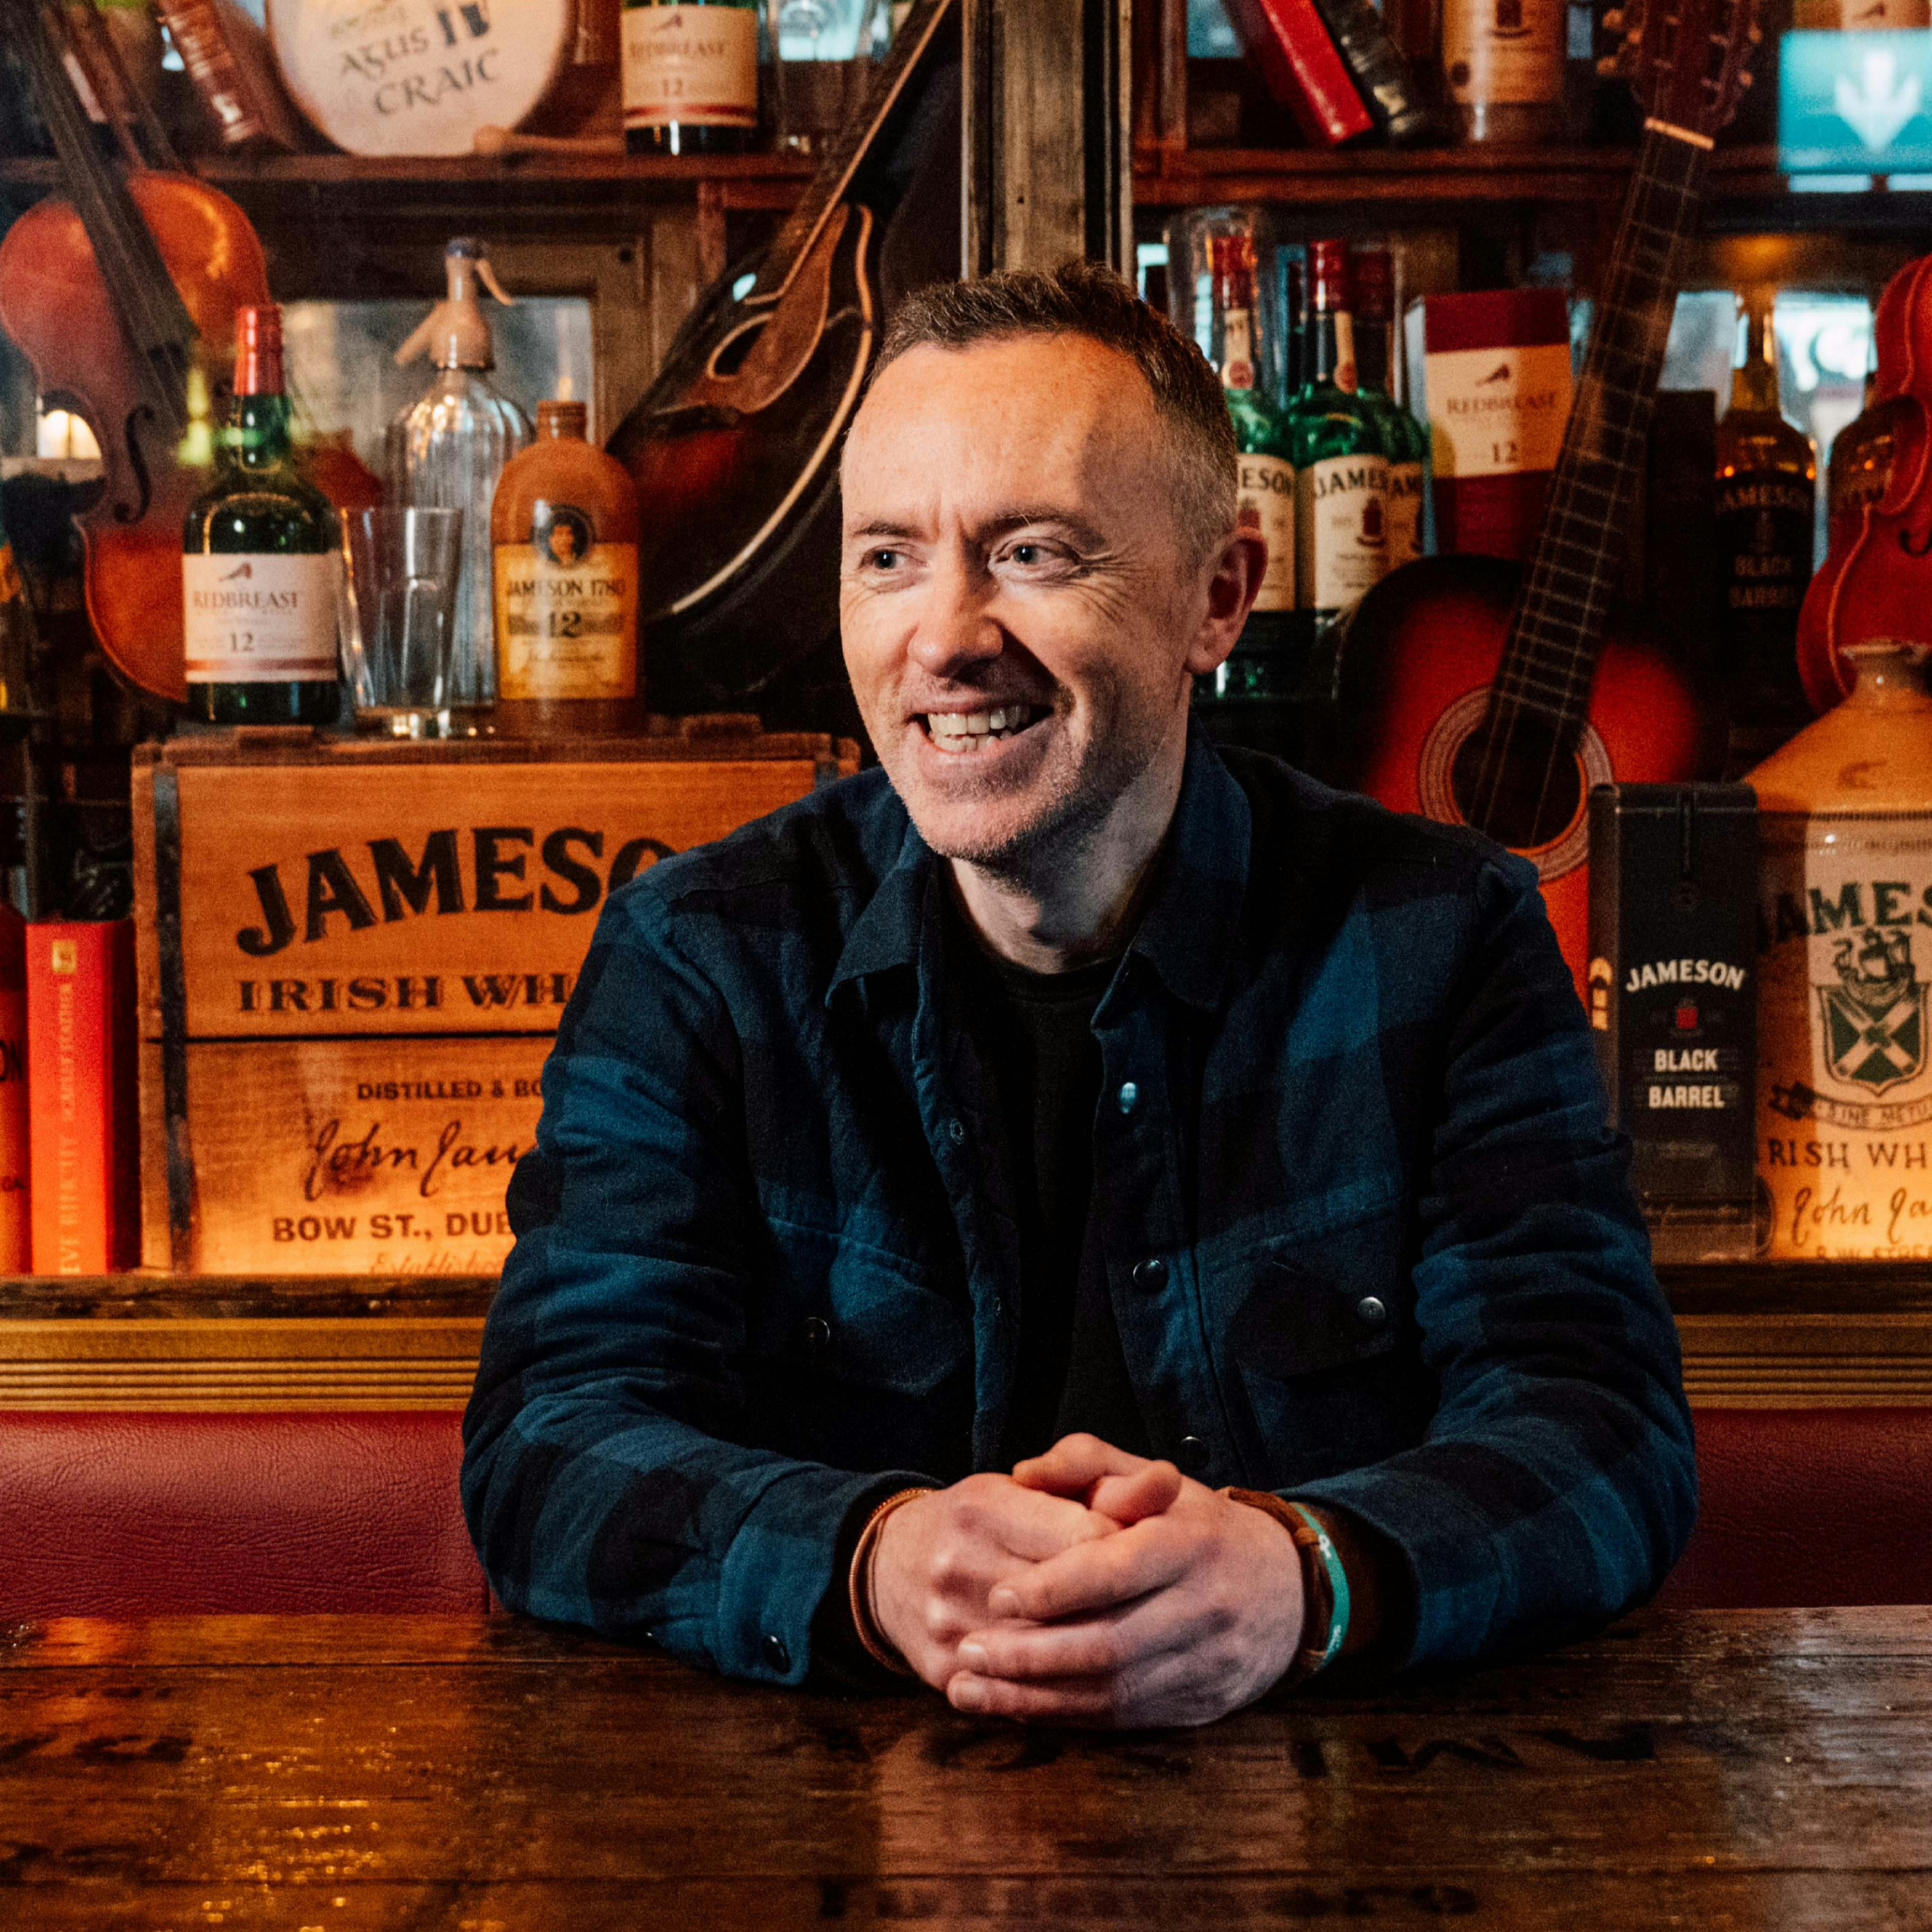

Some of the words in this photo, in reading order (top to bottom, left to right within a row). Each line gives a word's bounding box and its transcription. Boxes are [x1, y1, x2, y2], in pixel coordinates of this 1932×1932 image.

[373, 47, 500, 115] CRAIC
[663, 79, 683, 96] 12
[1447, 392, 1555, 414] REDBREAST
[1493, 439, 1519, 464] 12
[1242, 467, 1294, 495] ESON
[1316, 467, 1388, 500] JAMES
[194, 590, 298, 609] REDBREAST
[549, 611, 583, 638] 12
[230, 632, 254, 652] 12
[236, 826, 676, 958] JAMESO
[1625, 958, 1746, 992] JAMESON
[238, 975, 443, 1013] IRISH
[461, 973, 581, 1009] WH
[1654, 1048, 1719, 1073] BLACK
[357, 1081, 482, 1101] DISTILLED
[491, 1079, 504, 1099] &
[515, 1079, 542, 1098] BO
[1649, 1084, 1726, 1110] BARREL
[304, 1117, 419, 1202] John
[1768, 1139, 1850, 1168] RISH
[1867, 1142, 1927, 1169] WH
[272, 1216, 356, 1242] BOW
[370, 1214, 432, 1241] ST.,
[446, 1212, 514, 1236] DUB
[1791, 1186, 1871, 1247] John
[1888, 1187, 1932, 1245] Ja
